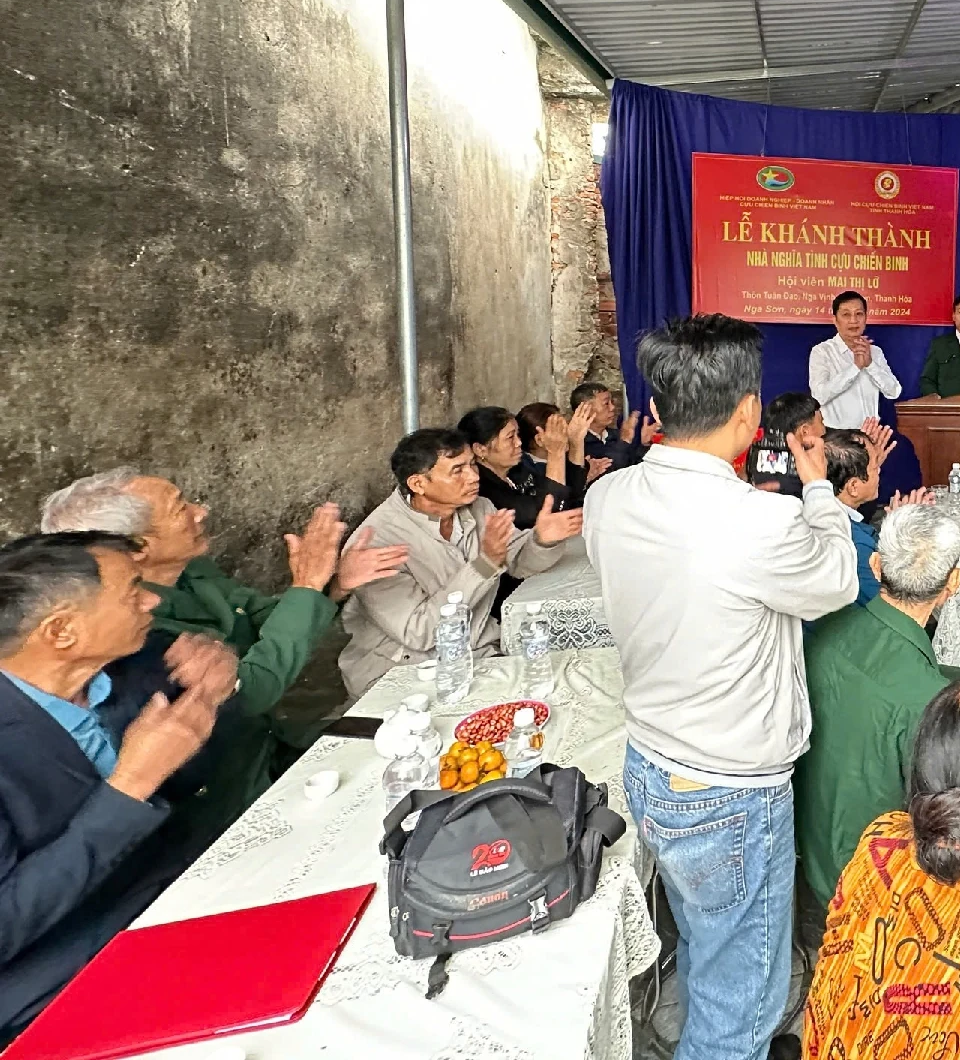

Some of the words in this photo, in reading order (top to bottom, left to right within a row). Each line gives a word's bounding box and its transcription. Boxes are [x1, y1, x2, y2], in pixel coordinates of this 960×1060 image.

[722, 211, 753, 242] LỄ
[760, 217, 846, 246] KHÁNH
[852, 221, 931, 250] THÀNH
[746, 248, 768, 267] NHÀ
[771, 249, 802, 268] NGHĨA
[805, 251, 828, 269] TÌNH
[853, 251, 883, 271] CHIẾN
[885, 255, 909, 272] BINH
[778, 276, 797, 288] Hội
[800, 277, 824, 287] viên
[828, 276, 847, 288] MAI
[850, 277, 865, 291] THỊ
[875, 294, 897, 303] Thanh
[743, 304, 763, 314] Nga
[815, 305, 825, 314] 14
[890, 308, 911, 316] 2024
